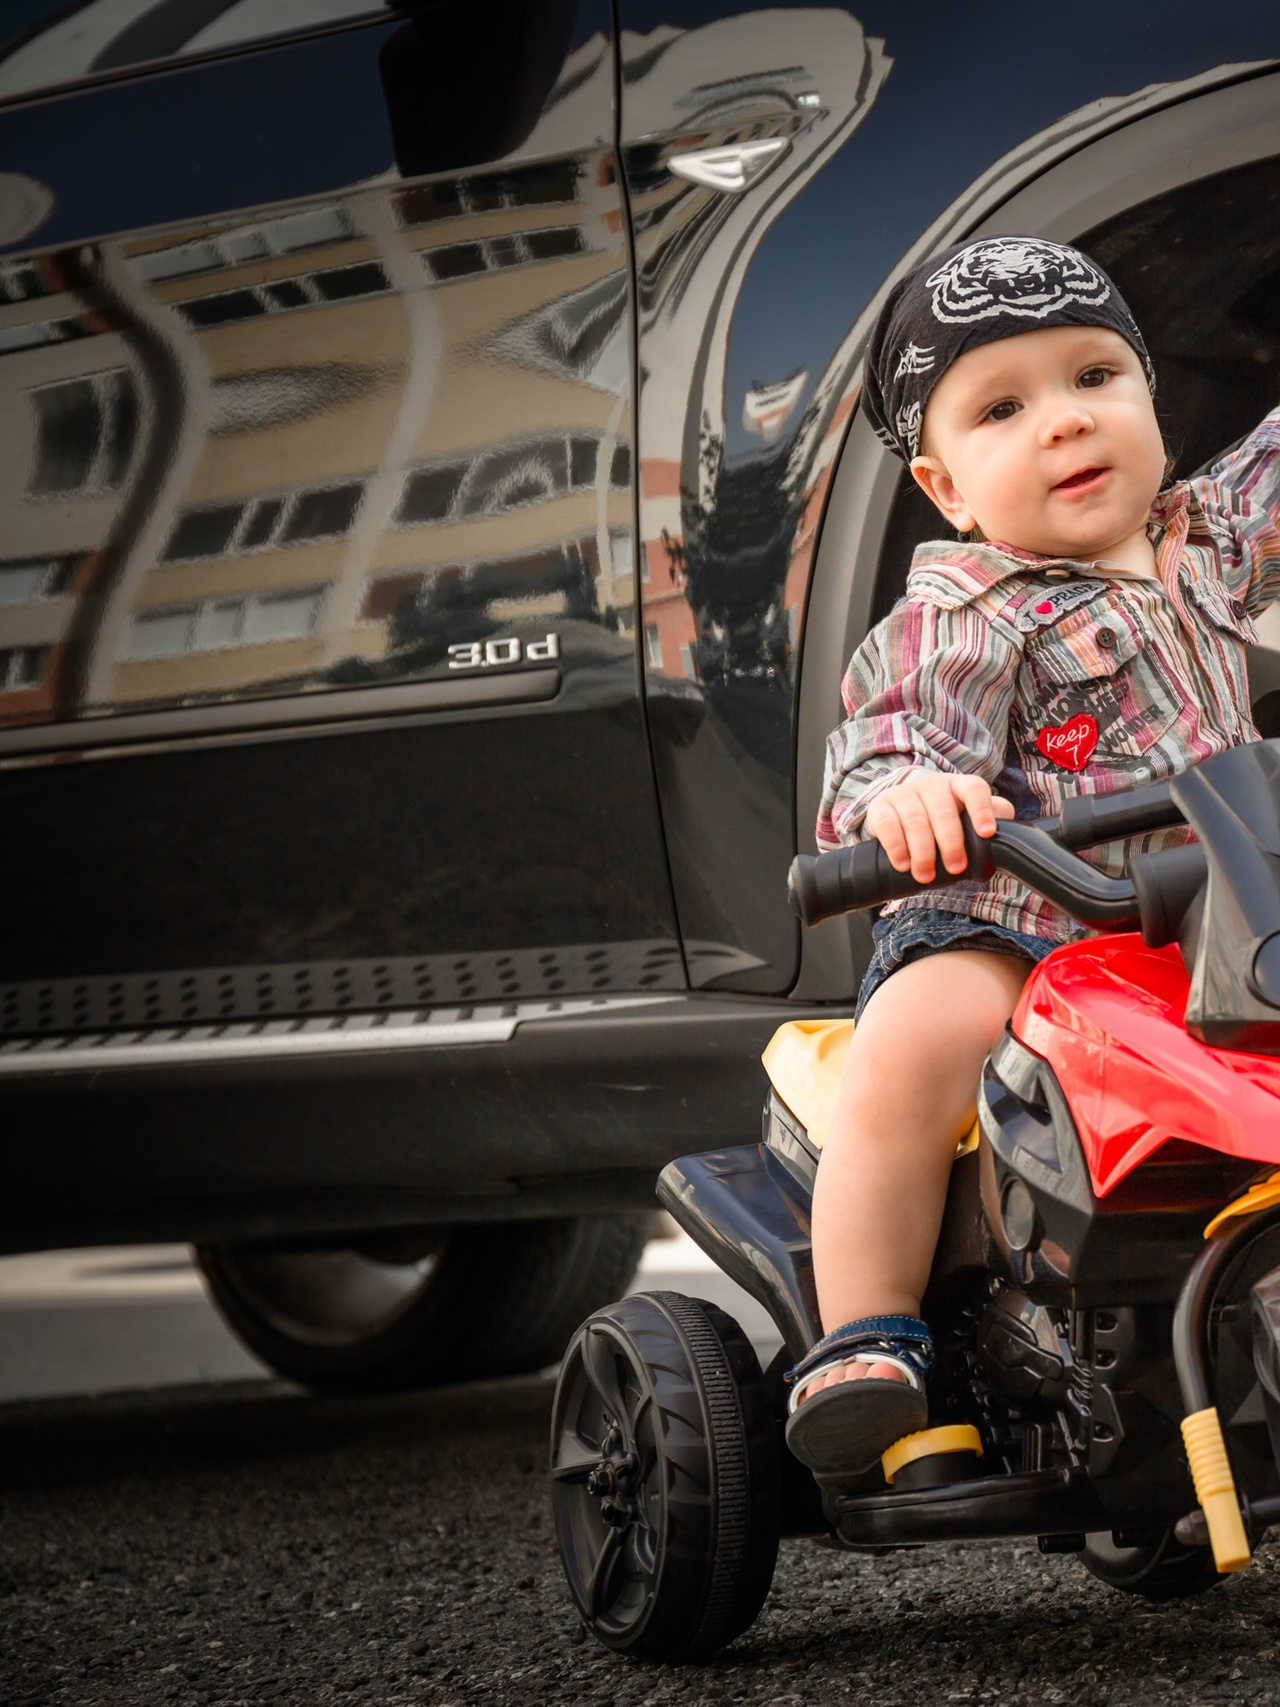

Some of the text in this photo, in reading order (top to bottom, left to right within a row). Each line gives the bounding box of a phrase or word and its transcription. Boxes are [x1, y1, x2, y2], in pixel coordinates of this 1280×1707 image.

[1023, 583, 1099, 626] I PEACE
[1099, 703, 1166, 752] WONDER
